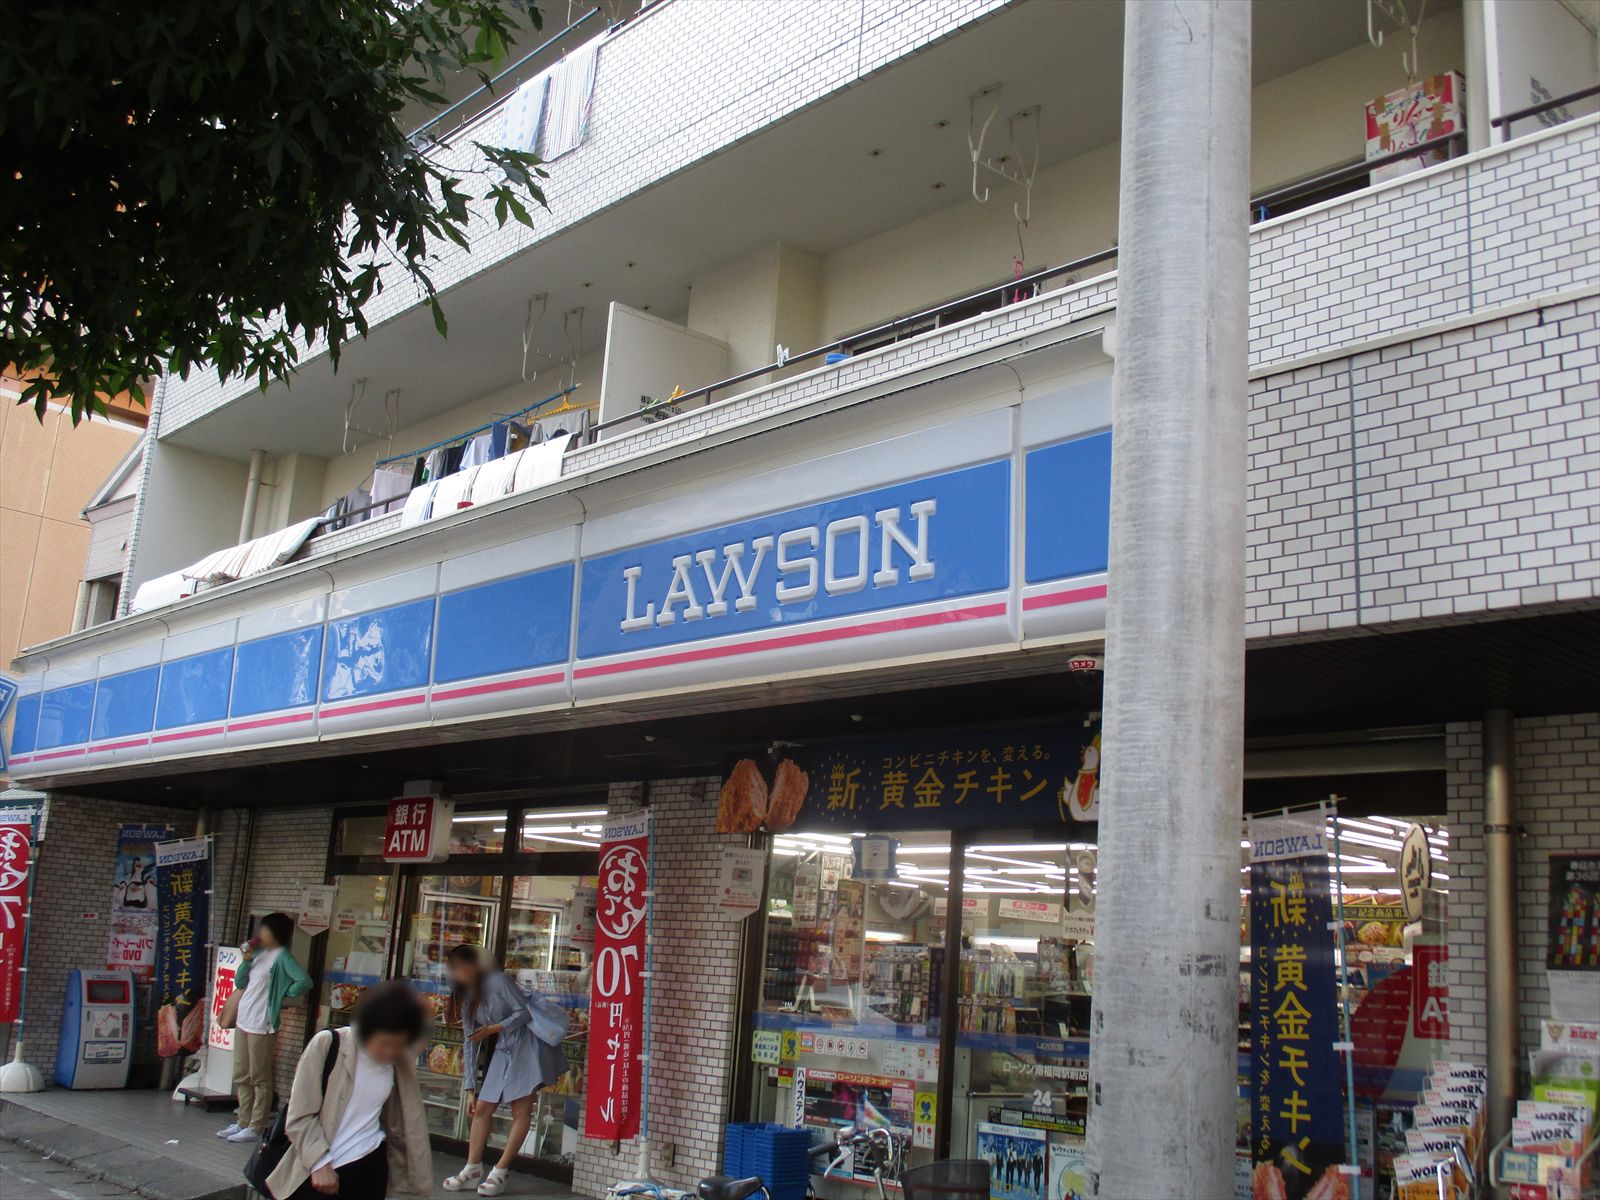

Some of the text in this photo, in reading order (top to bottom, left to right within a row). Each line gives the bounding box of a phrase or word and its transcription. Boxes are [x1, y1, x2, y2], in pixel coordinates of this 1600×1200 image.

[621, 499, 936, 634] LAWSON
[882, 745, 1050, 769] コンビニチキンを、変える。
[826, 763, 1048, 810] 新 黄金チキン
[394, 803, 426, 826] 銀行
[388, 829, 426, 853] ATM
[1033, 1089, 1052, 1107] 24
[1432, 1115, 1469, 1126] WORK
[1531, 1126, 1574, 1140] WORK
